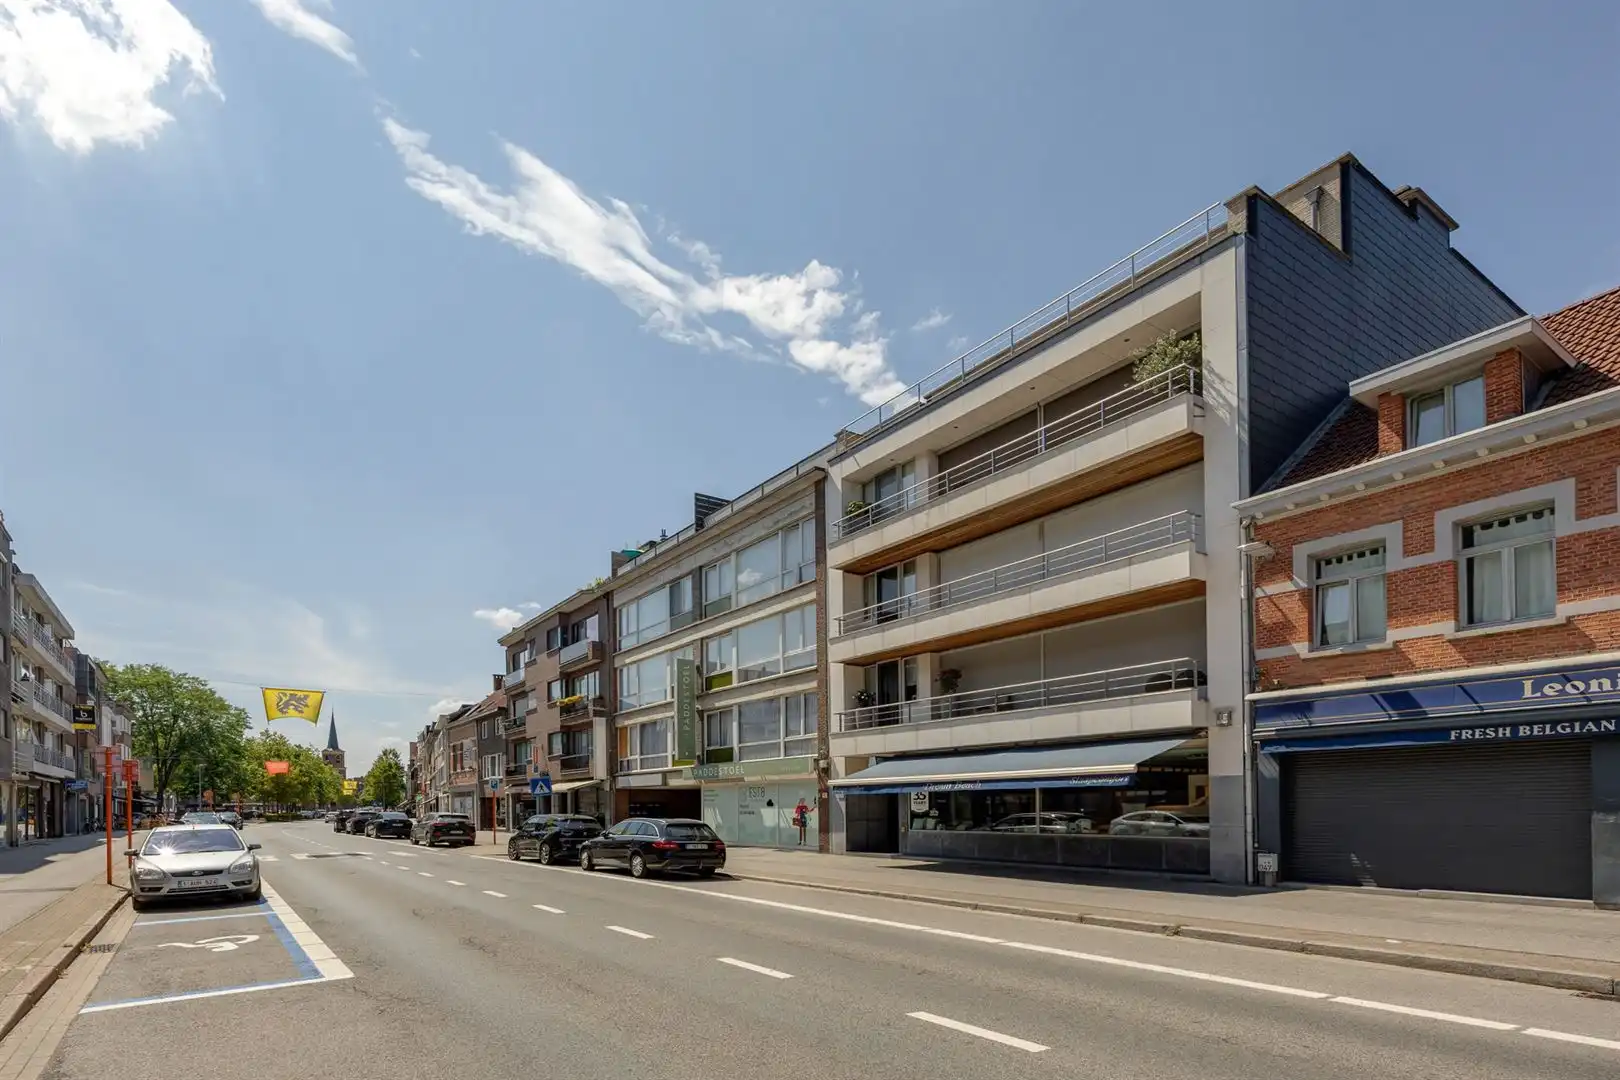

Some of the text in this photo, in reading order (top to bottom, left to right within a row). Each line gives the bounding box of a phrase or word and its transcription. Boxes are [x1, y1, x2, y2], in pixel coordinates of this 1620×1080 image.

[1450, 719, 1617, 740] FRESH BELGIAN
[694, 765, 745, 777] PADDESTOEL
